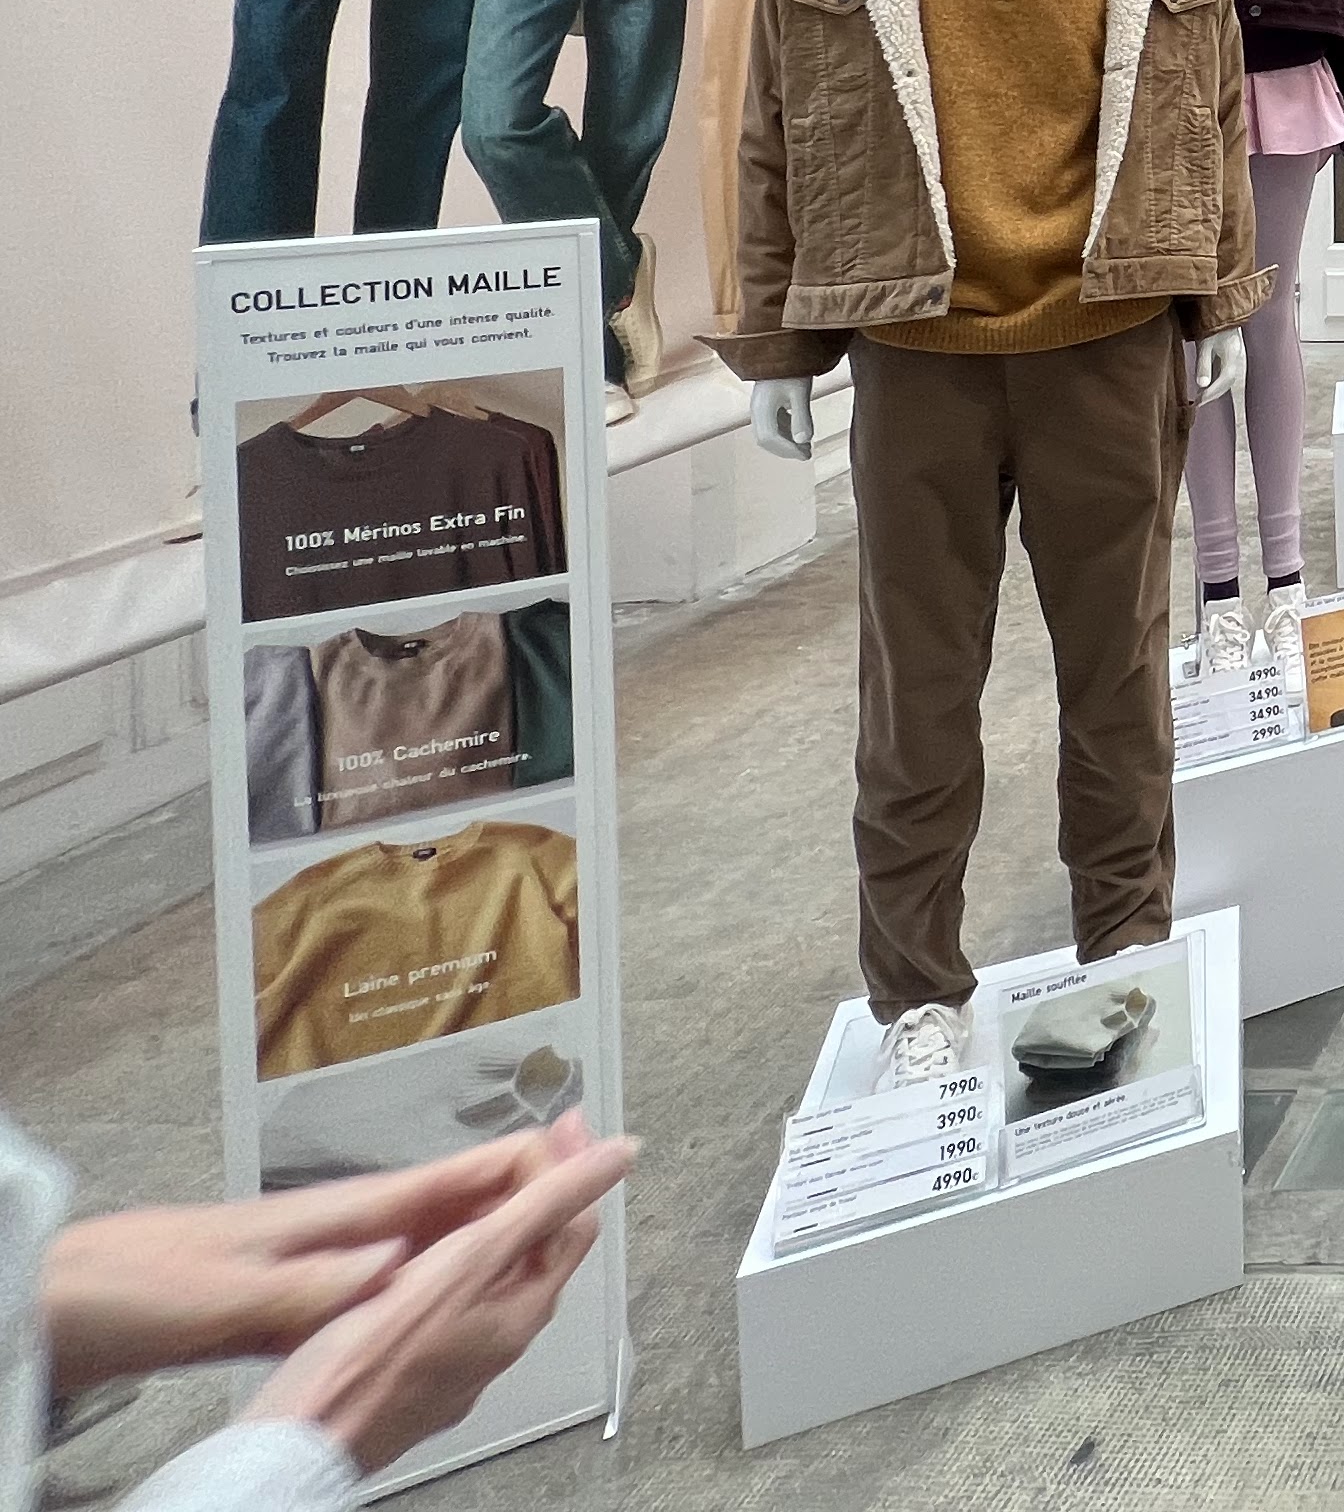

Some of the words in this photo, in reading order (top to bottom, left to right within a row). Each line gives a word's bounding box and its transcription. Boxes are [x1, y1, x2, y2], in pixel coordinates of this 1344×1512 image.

[230, 276, 433, 314] COLLECTION
[447, 266, 562, 297] MAILLE
[240, 331, 307, 345] Textures
[314, 327, 329, 339] et
[335, 322, 399, 337] couleurs
[405, 318, 443, 331] d'une
[449, 313, 499, 326] intense
[267, 349, 327, 364] Trouvez
[333, 346, 348, 357] la
[354, 340, 399, 355] maille
[405, 338, 427, 352] qui
[433, 335, 465, 347] vous
[285, 530, 335, 552] 100%
[344, 520, 422, 544] Mérinos
[430, 512, 487, 532] Extra
[494, 504, 526, 523] Fin
[336, 749, 385, 773] 100%
[392, 729, 500, 761] Cachemire
[344, 974, 399, 998] Laine
[407, 950, 498, 985] premium
[1011, 987, 1042, 1004] Maille
[1046, 973, 1087, 993] soufflée
